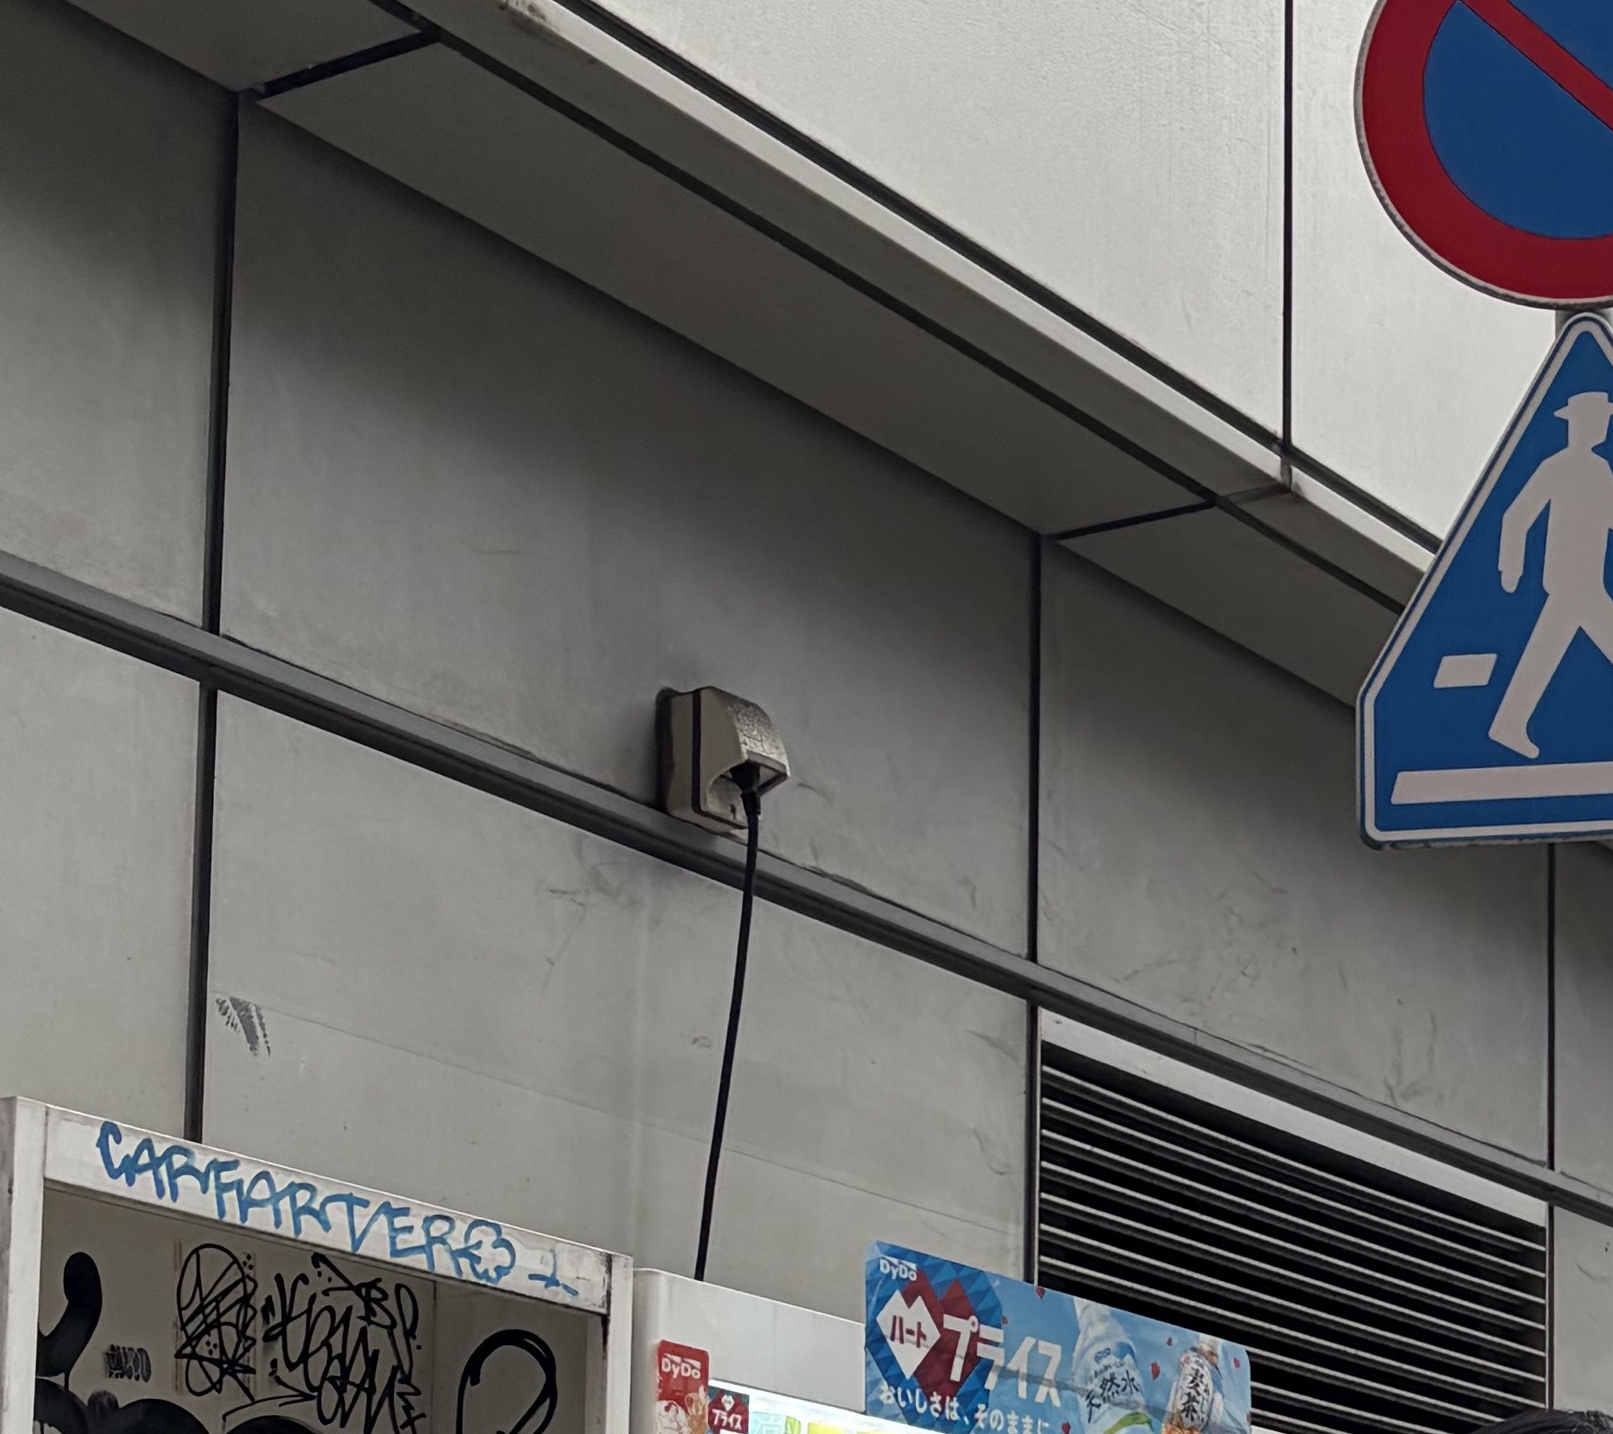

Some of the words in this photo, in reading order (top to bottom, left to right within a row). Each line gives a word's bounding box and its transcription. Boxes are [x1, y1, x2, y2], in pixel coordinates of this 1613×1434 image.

[879, 1256, 917, 1282] DyDo
[889, 1314, 928, 1349] ハート
[661, 1353, 701, 1379] DyDo
[943, 1311, 1062, 1408] プライス
